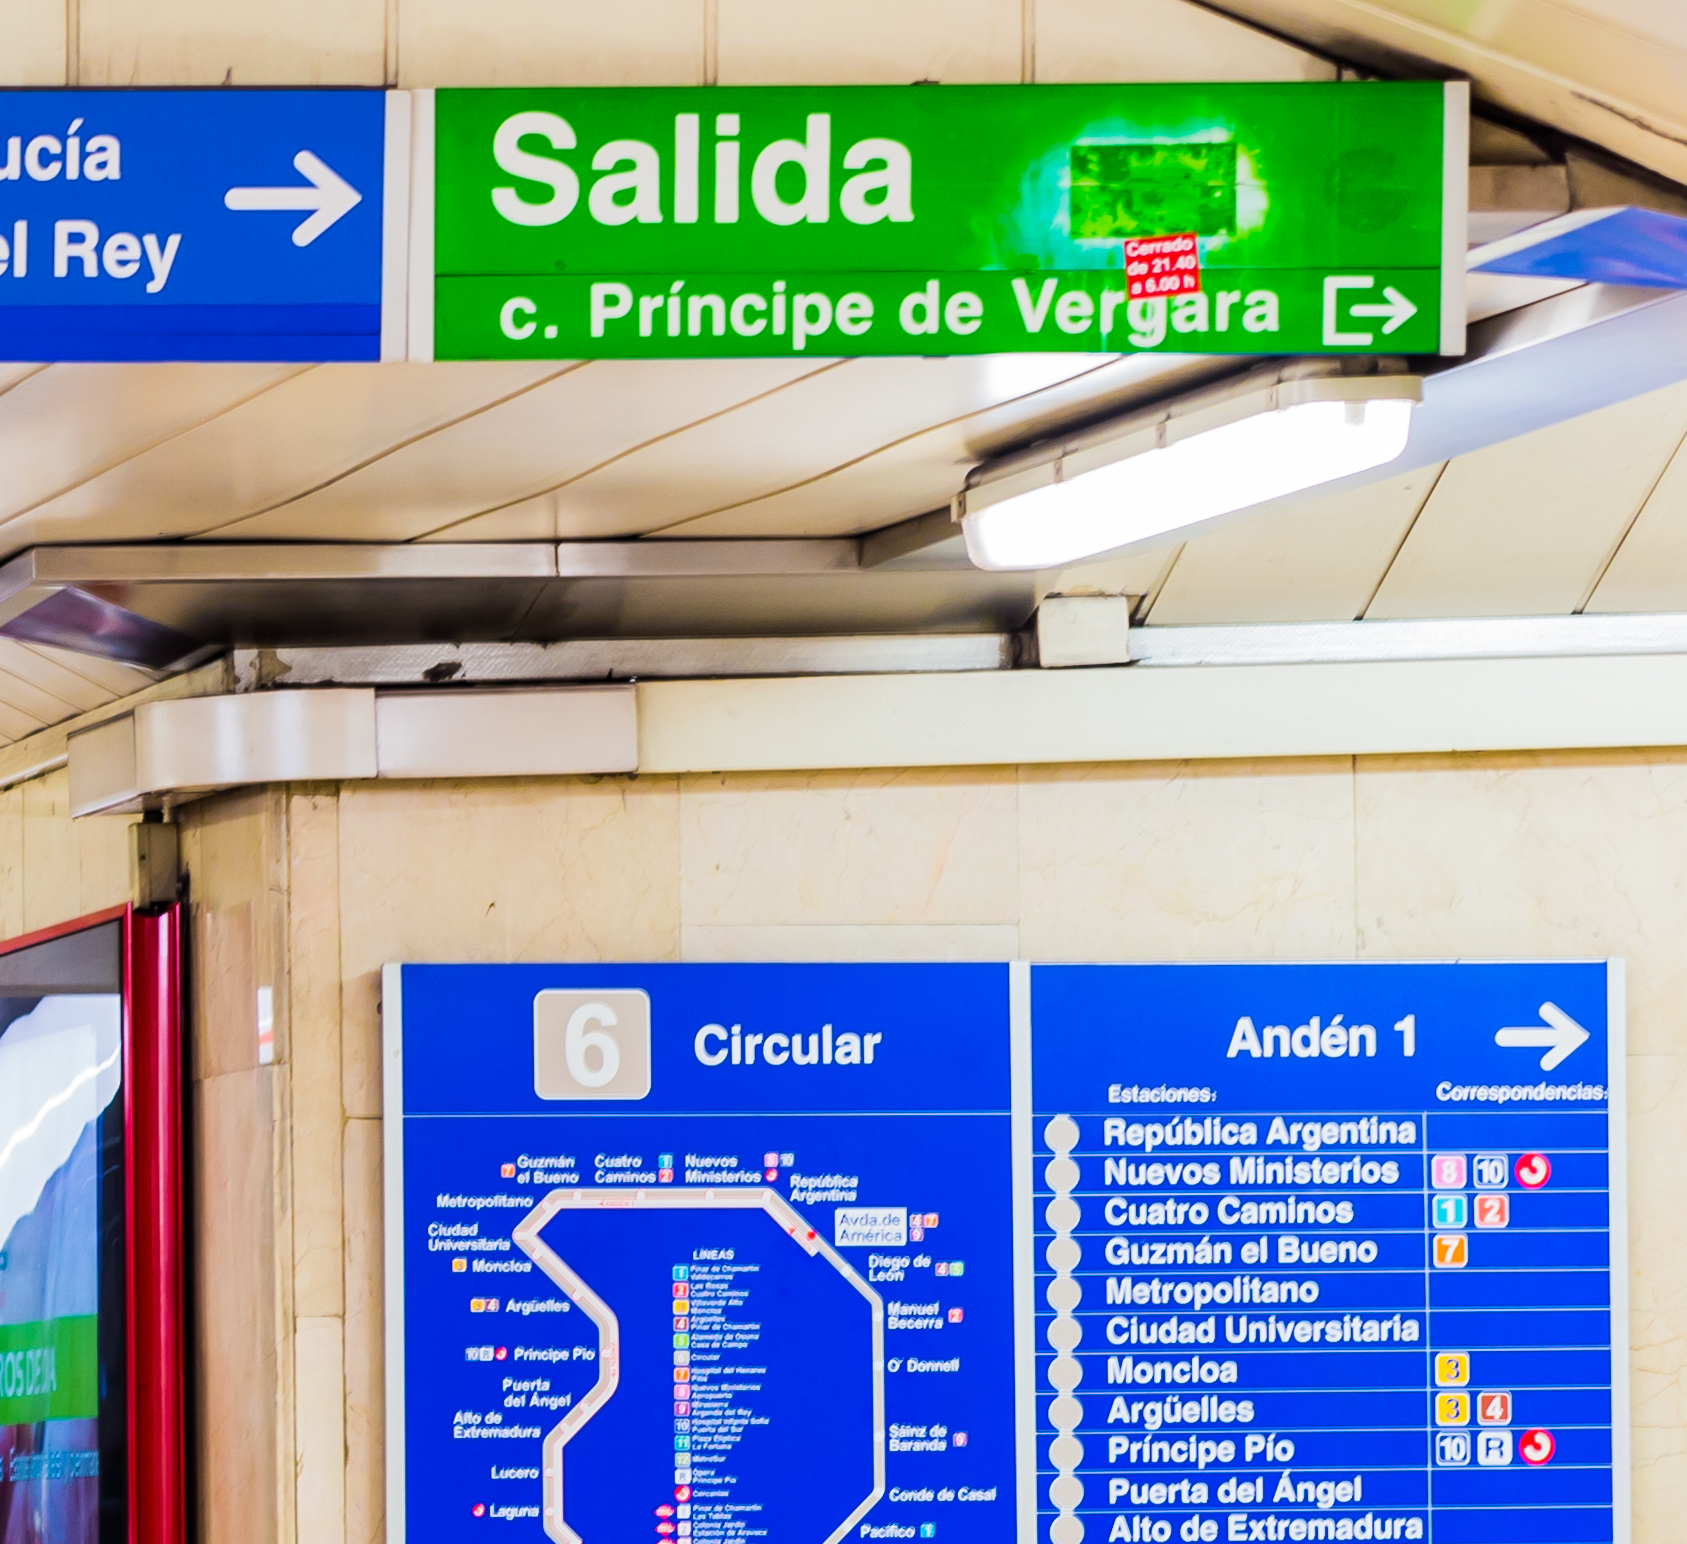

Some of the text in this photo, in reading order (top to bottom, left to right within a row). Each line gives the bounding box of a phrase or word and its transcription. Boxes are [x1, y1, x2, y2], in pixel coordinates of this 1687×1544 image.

[492, 111, 914, 226] Salida
[1126, 237, 1194, 257] Cerrado
[54, 220, 181, 293] Rey
[1127, 254, 1196, 276] de 21.40
[1130, 274, 1195, 295] a 6.00 h
[500, 279, 1280, 350] c. Príncipe de Vergara
[565, 1002, 882, 1088] 6 Circular
[1227, 1014, 1415, 1058] Andén 1
[1108, 1084, 1216, 1103] Estaciones:
[1435, 1082, 1608, 1104] Correspondencias:
[1104, 1116, 1417, 1153] República Argentina
[517, 1153, 575, 1168] Guzmán
[595, 1153, 642, 1168] Cuatro
[685, 1154, 738, 1168] Nuevos
[517, 1170, 580, 1184] el Bueno
[595, 1169, 656, 1184] Caminos
[685, 1169, 761, 1183] Ministerios
[1104, 1156, 1400, 1186] Nuevos Ministerios
[1440, 1158, 1505, 1186] 8 10
[790, 1173, 858, 1190] República
[437, 1193, 534, 1210] Metropolitano
[790, 1189, 857, 1205] Argentina
[1104, 1196, 1354, 1227] Cuatro Caminos
[1442, 1199, 1500, 1223] 1 2
[428, 1222, 478, 1237] Ciudad
[839, 1228, 902, 1242] América
[428, 1238, 510, 1251] Universitaria
[1105, 1234, 1378, 1266] Guzmán el Bueno
[1441, 1239, 1459, 1263] 7
[472, 1259, 532, 1272] Moncloa
[869, 1253, 931, 1270] Diego de
[869, 1269, 905, 1281] León
[1106, 1275, 1319, 1311] Metropolitano
[506, 1298, 570, 1315] Argüelles
[888, 1300, 940, 1315] Manuel
[888, 1316, 943, 1329] Becerra
[1106, 1315, 1420, 1344] Ciudad Universitaria
[907, 1357, 960, 1372] Donnell
[1107, 1357, 1237, 1384] Moncloa
[1445, 1359, 1461, 1380] 3
[502, 1377, 550, 1391] Puerta
[504, 1391, 571, 1410] del Ángel
[1445, 1397, 1504, 1420] 3 4
[453, 1410, 503, 1424] Alto de
[1107, 1396, 1255, 1431] Argüelles
[453, 1424, 541, 1438] Extremadura
[929, 1422, 947, 1438] de
[889, 1439, 947, 1451] Baranda
[1108, 1434, 1294, 1469] Príncipe Pío
[1439, 1436, 1467, 1462] 10
[491, 1465, 539, 1480] Lucero
[889, 1486, 997, 1502] Conde de Casal
[1109, 1470, 1362, 1508] Puerta del Ángel
[490, 1504, 539, 1520] Laguna
[860, 1523, 915, 1538] Pacífico
[1109, 1512, 1423, 1544] Alto de Extremadura
